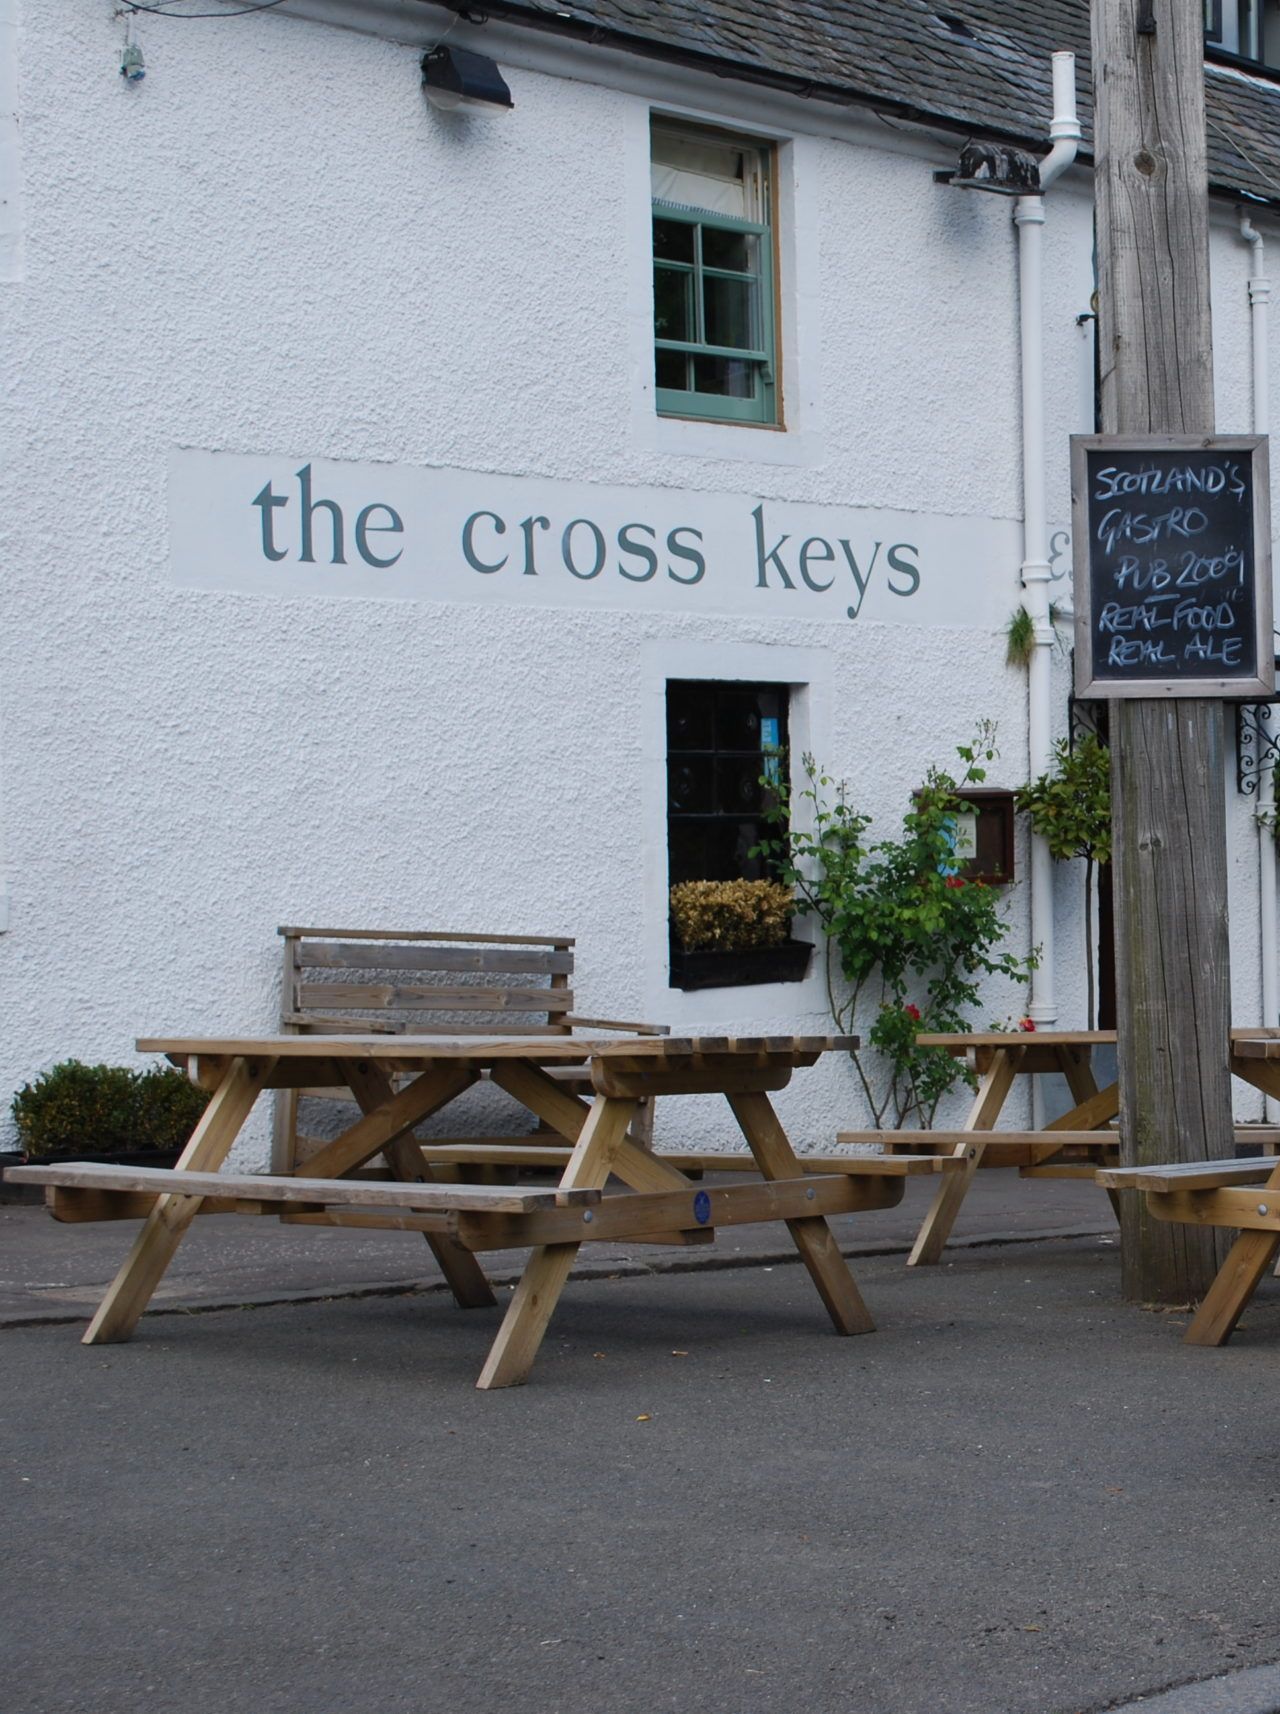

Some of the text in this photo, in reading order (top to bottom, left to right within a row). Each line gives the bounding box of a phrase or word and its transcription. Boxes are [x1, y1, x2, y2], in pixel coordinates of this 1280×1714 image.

[251, 461, 405, 570] the
[461, 509, 707, 586] cross
[751, 502, 922, 620] keys
[1097, 506, 1209, 555] GASTRO
[1114, 555, 1171, 590] PUB
[1175, 550, 1245, 588] 2009
[1099, 597, 1235, 633] REAL FOOD
[1107, 632, 1242, 666] REAL ALE
